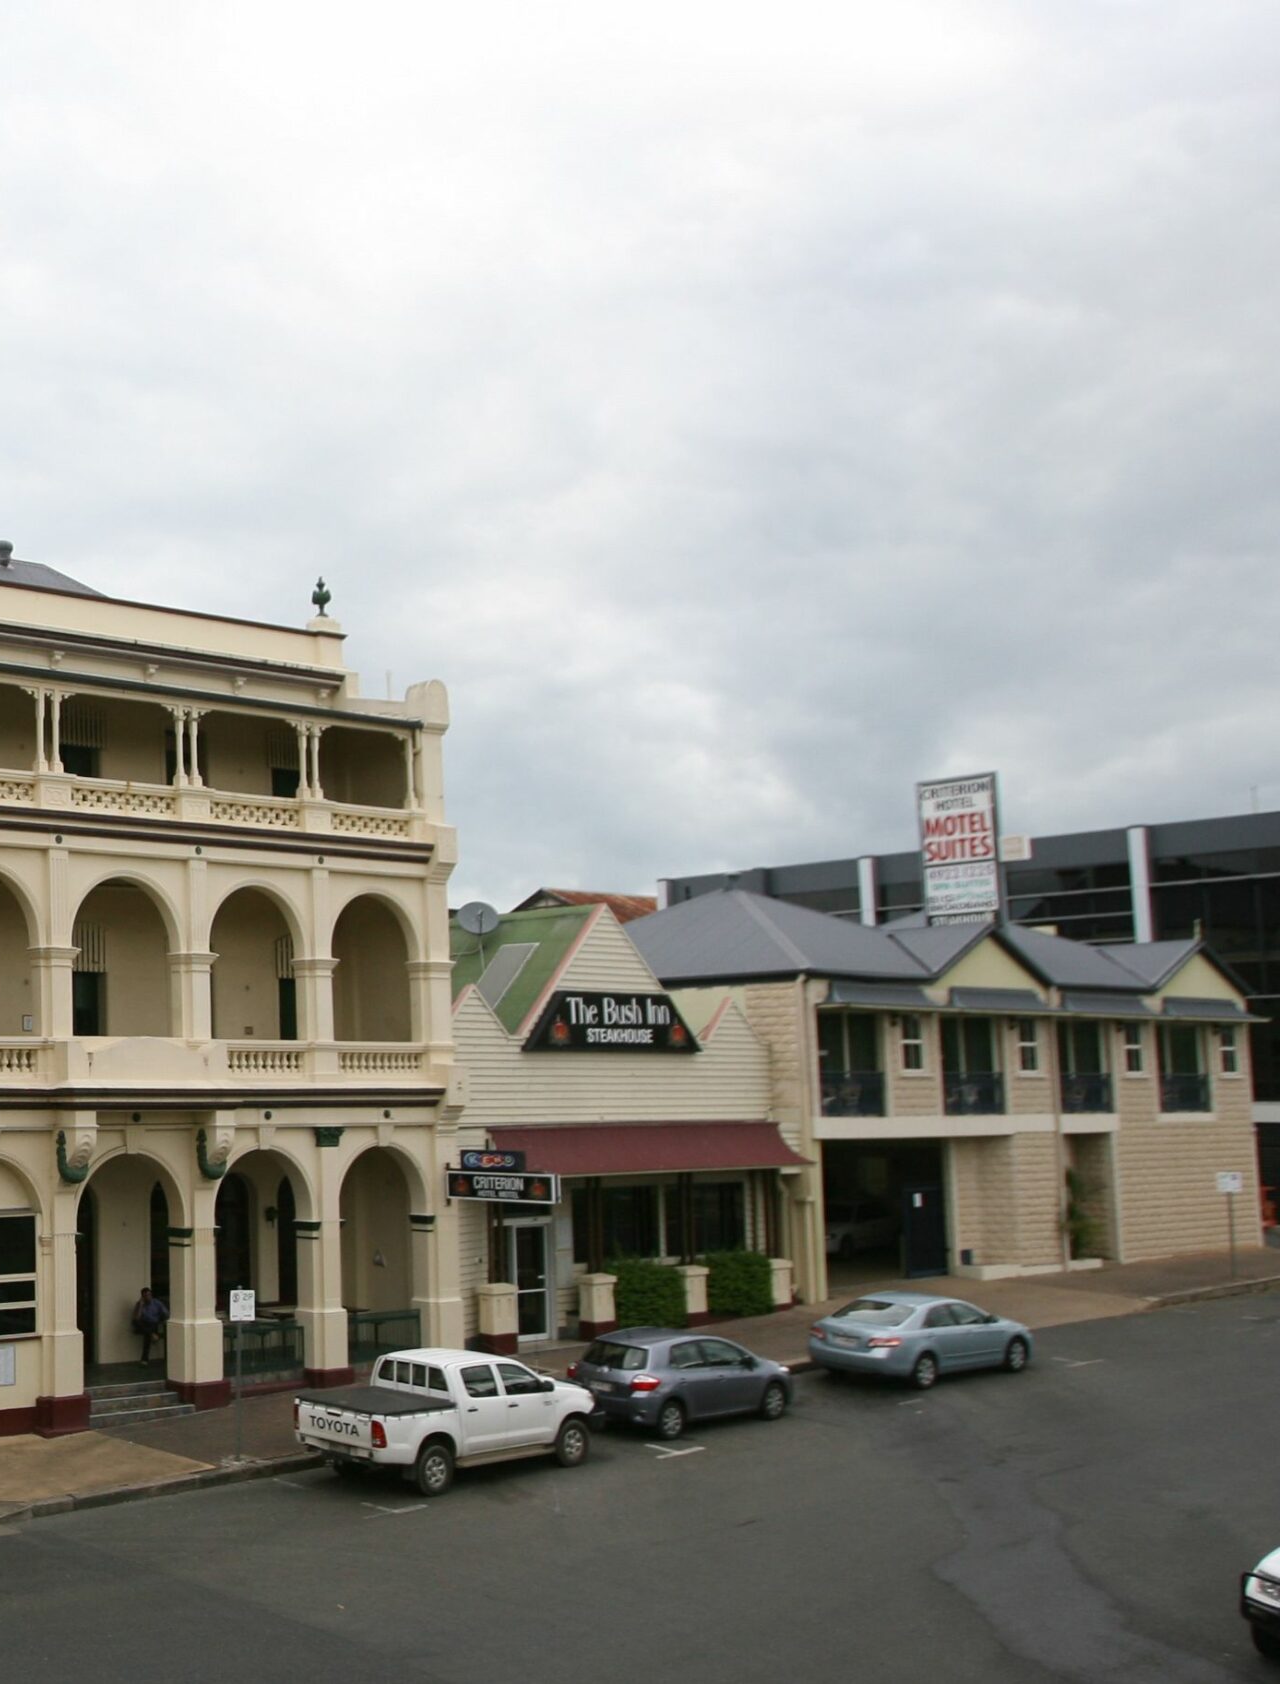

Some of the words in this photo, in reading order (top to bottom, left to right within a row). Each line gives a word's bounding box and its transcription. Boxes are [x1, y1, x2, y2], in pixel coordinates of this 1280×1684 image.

[923, 781, 989, 800] CRITERION
[935, 796, 977, 811] HOTEL
[924, 811, 990, 836] MOTEL
[925, 835, 993, 862] SUITES
[566, 996, 599, 1025] The
[602, 997, 643, 1025] Bush
[646, 998, 671, 1025] Inn
[587, 1028, 654, 1043] STEAKHOUSE
[473, 1175, 524, 1191] CRITERION
[477, 1189, 497, 1198] HOTEL
[498, 1190, 519, 1199] MOTEL
[309, 1415, 360, 1437] TOYOTA
